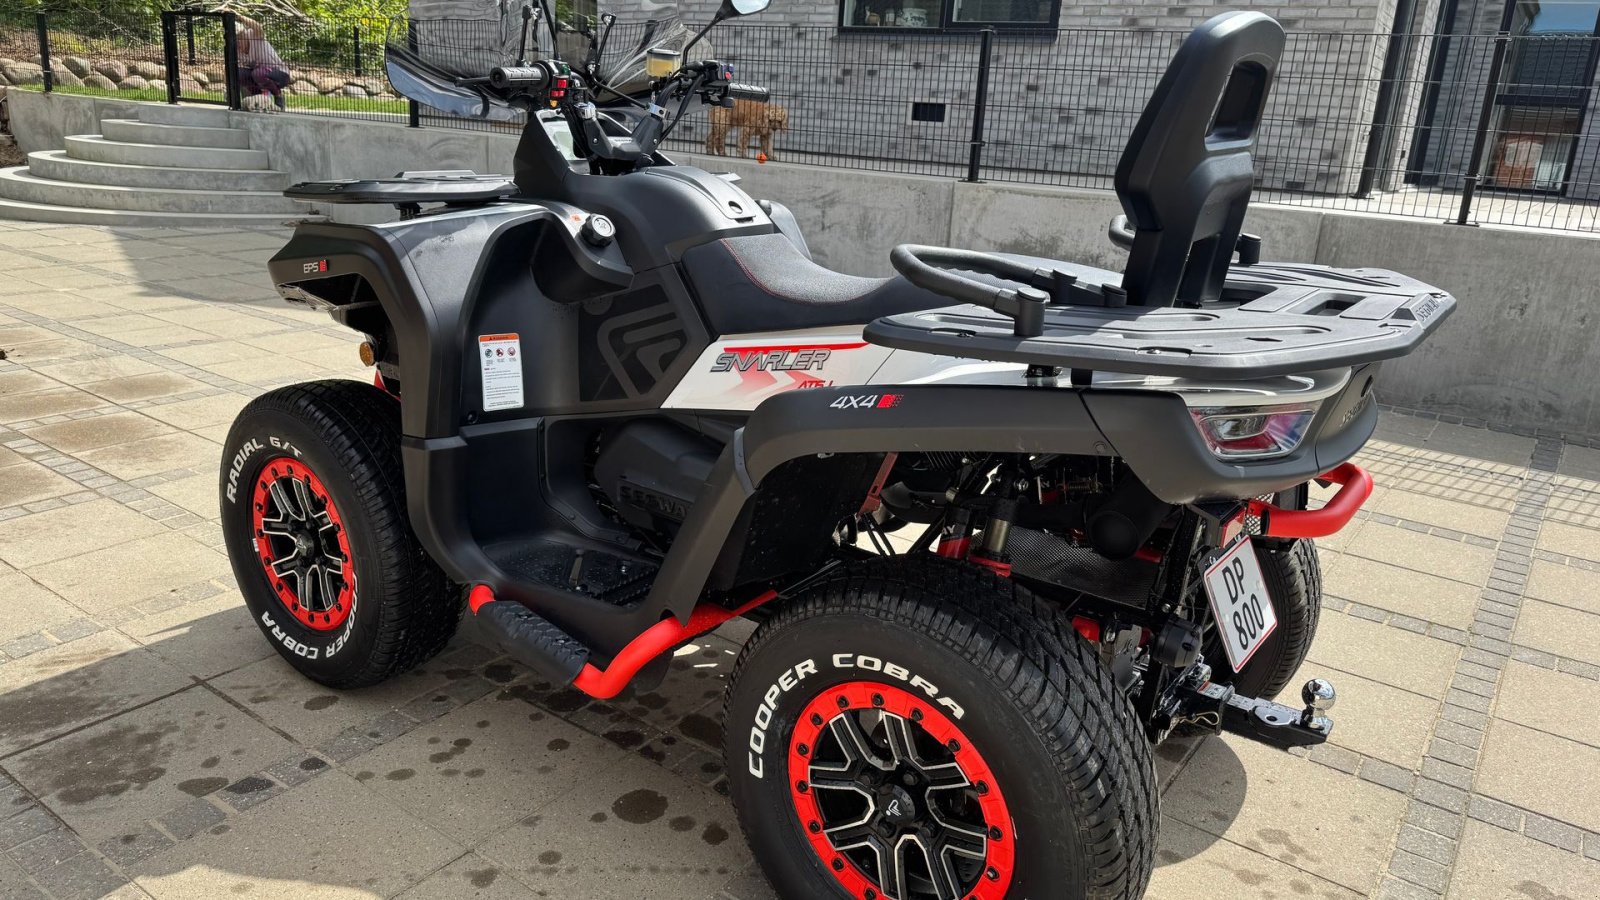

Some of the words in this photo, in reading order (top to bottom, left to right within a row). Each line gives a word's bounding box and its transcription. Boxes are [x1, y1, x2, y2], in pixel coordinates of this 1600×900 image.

[303, 262, 319, 274] EPS
[710, 349, 831, 373] SNARLER
[226, 438, 265, 504] RADIAL
[1222, 556, 1245, 605] DP
[261, 611, 319, 659] COBRA
[1232, 593, 1265, 650] 800
[748, 658, 819, 779] COOPER
[832, 653, 965, 720] COBRA
